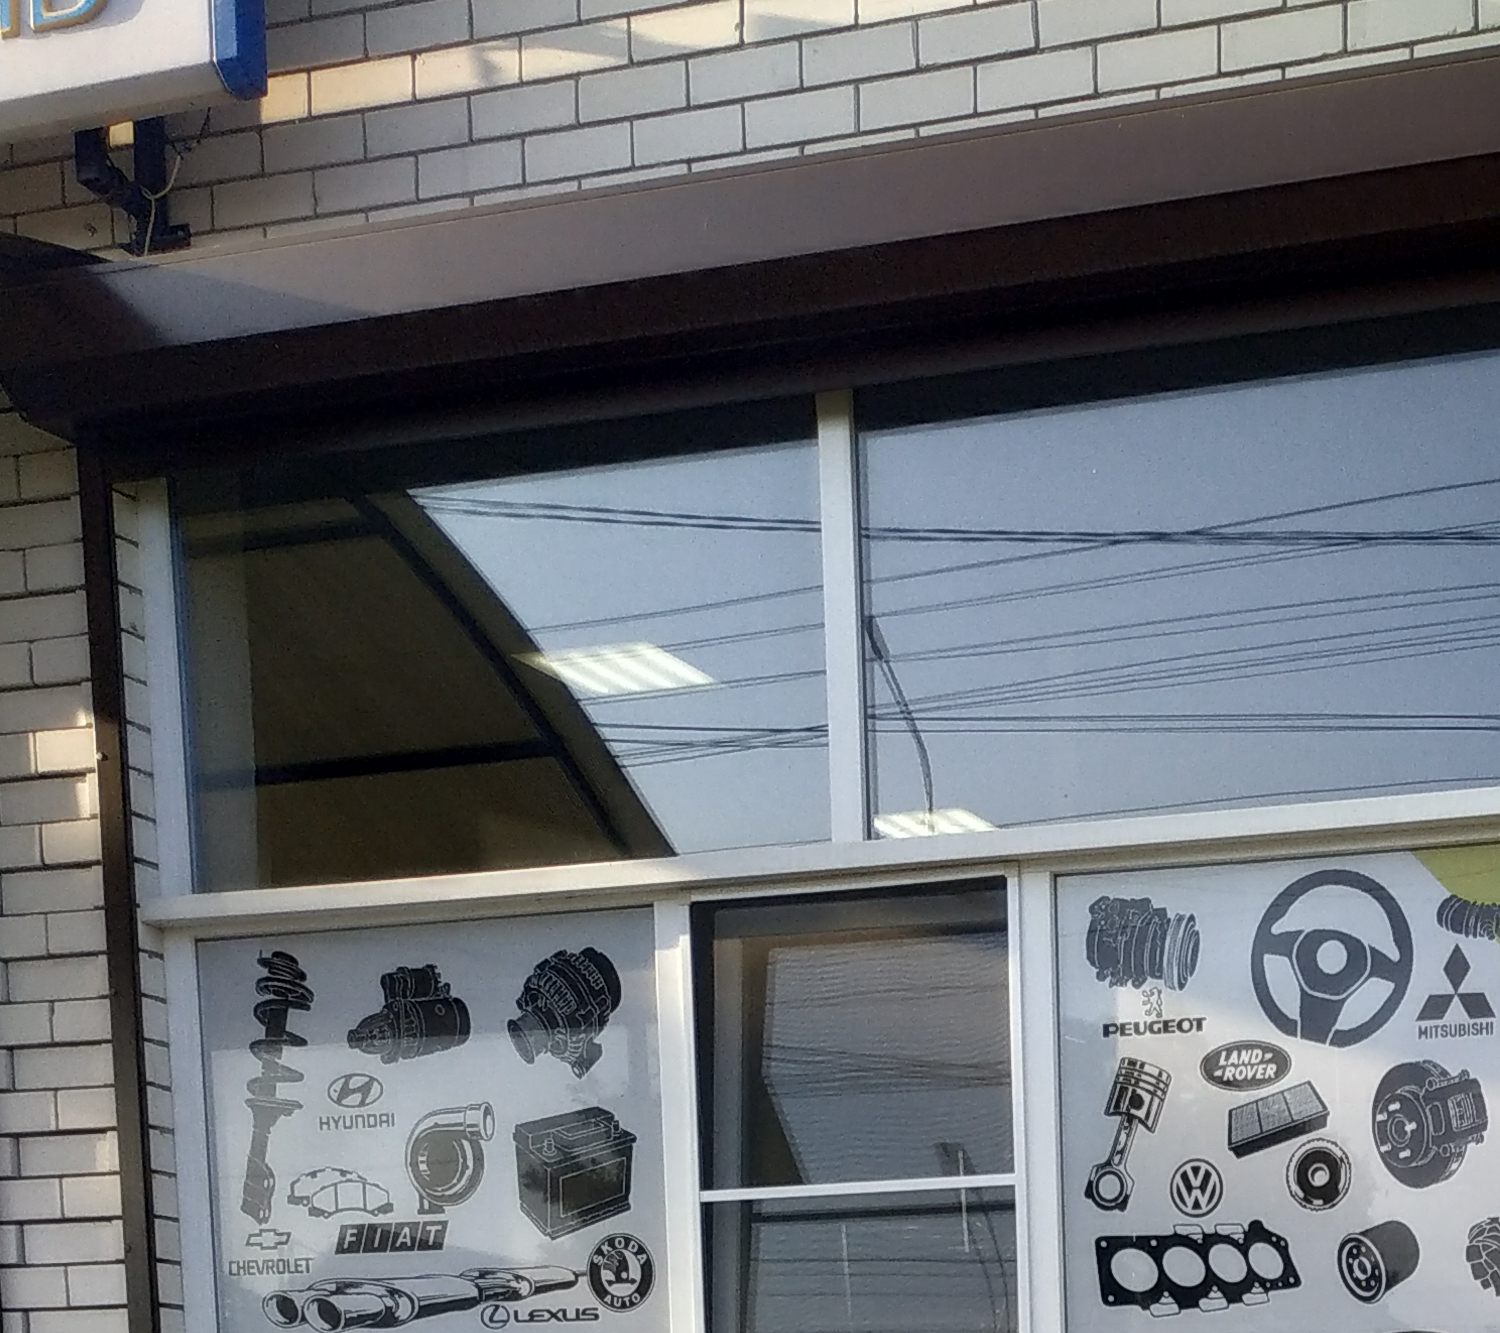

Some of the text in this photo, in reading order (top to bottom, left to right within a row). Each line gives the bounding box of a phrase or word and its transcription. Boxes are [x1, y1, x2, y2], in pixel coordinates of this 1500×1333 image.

[1102, 1017, 1207, 1038] PEUGEOT
[1417, 1021, 1494, 1040] MITSUBISHI
[319, 1112, 395, 1131] HYUNDAI
[343, 1224, 443, 1249] FIAT
[592, 1236, 650, 1266] SKODA
[228, 1257, 314, 1276] CHEVROLET
[603, 1292, 641, 1308] AUTO
[513, 1307, 601, 1324] LEXUS
